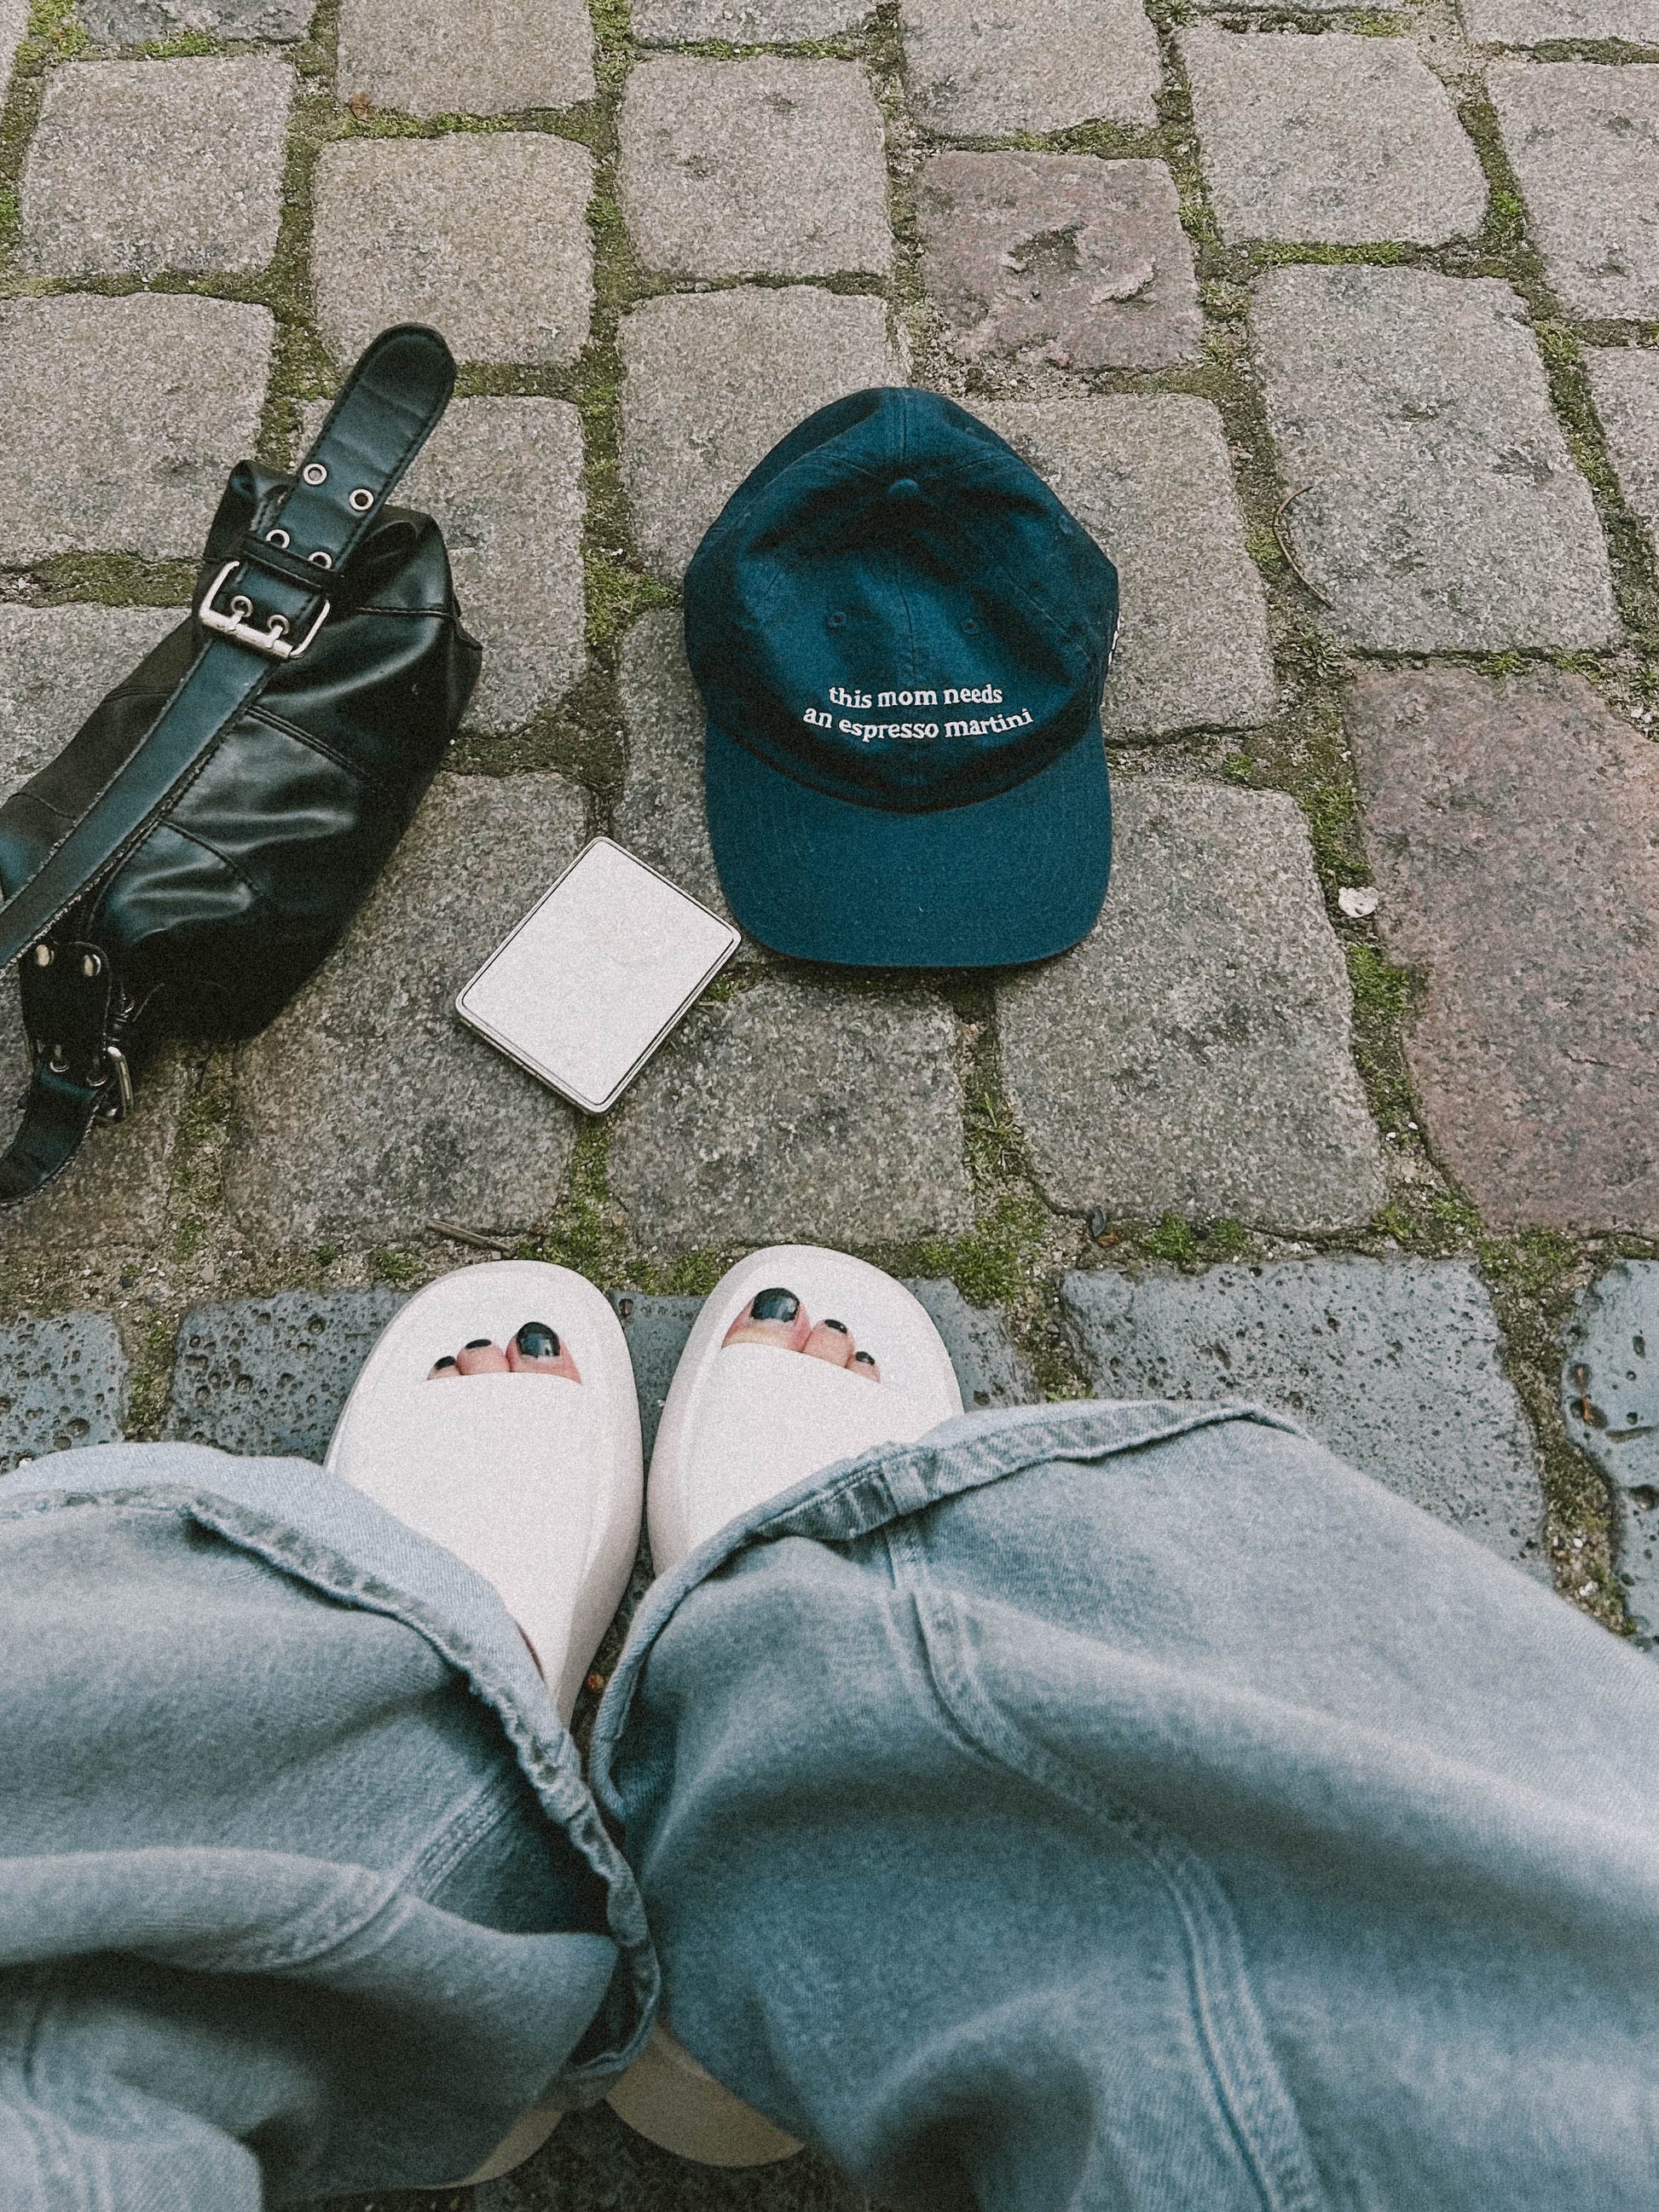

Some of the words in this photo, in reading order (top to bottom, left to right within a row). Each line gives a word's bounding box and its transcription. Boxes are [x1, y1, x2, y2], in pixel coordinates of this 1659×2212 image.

[829, 686, 872, 709] this
[877, 690, 938, 707] mom
[943, 684, 1003, 705] needs
[803, 707, 833, 729] an
[838, 719, 939, 742] espresso
[944, 708, 1034, 738] martini
